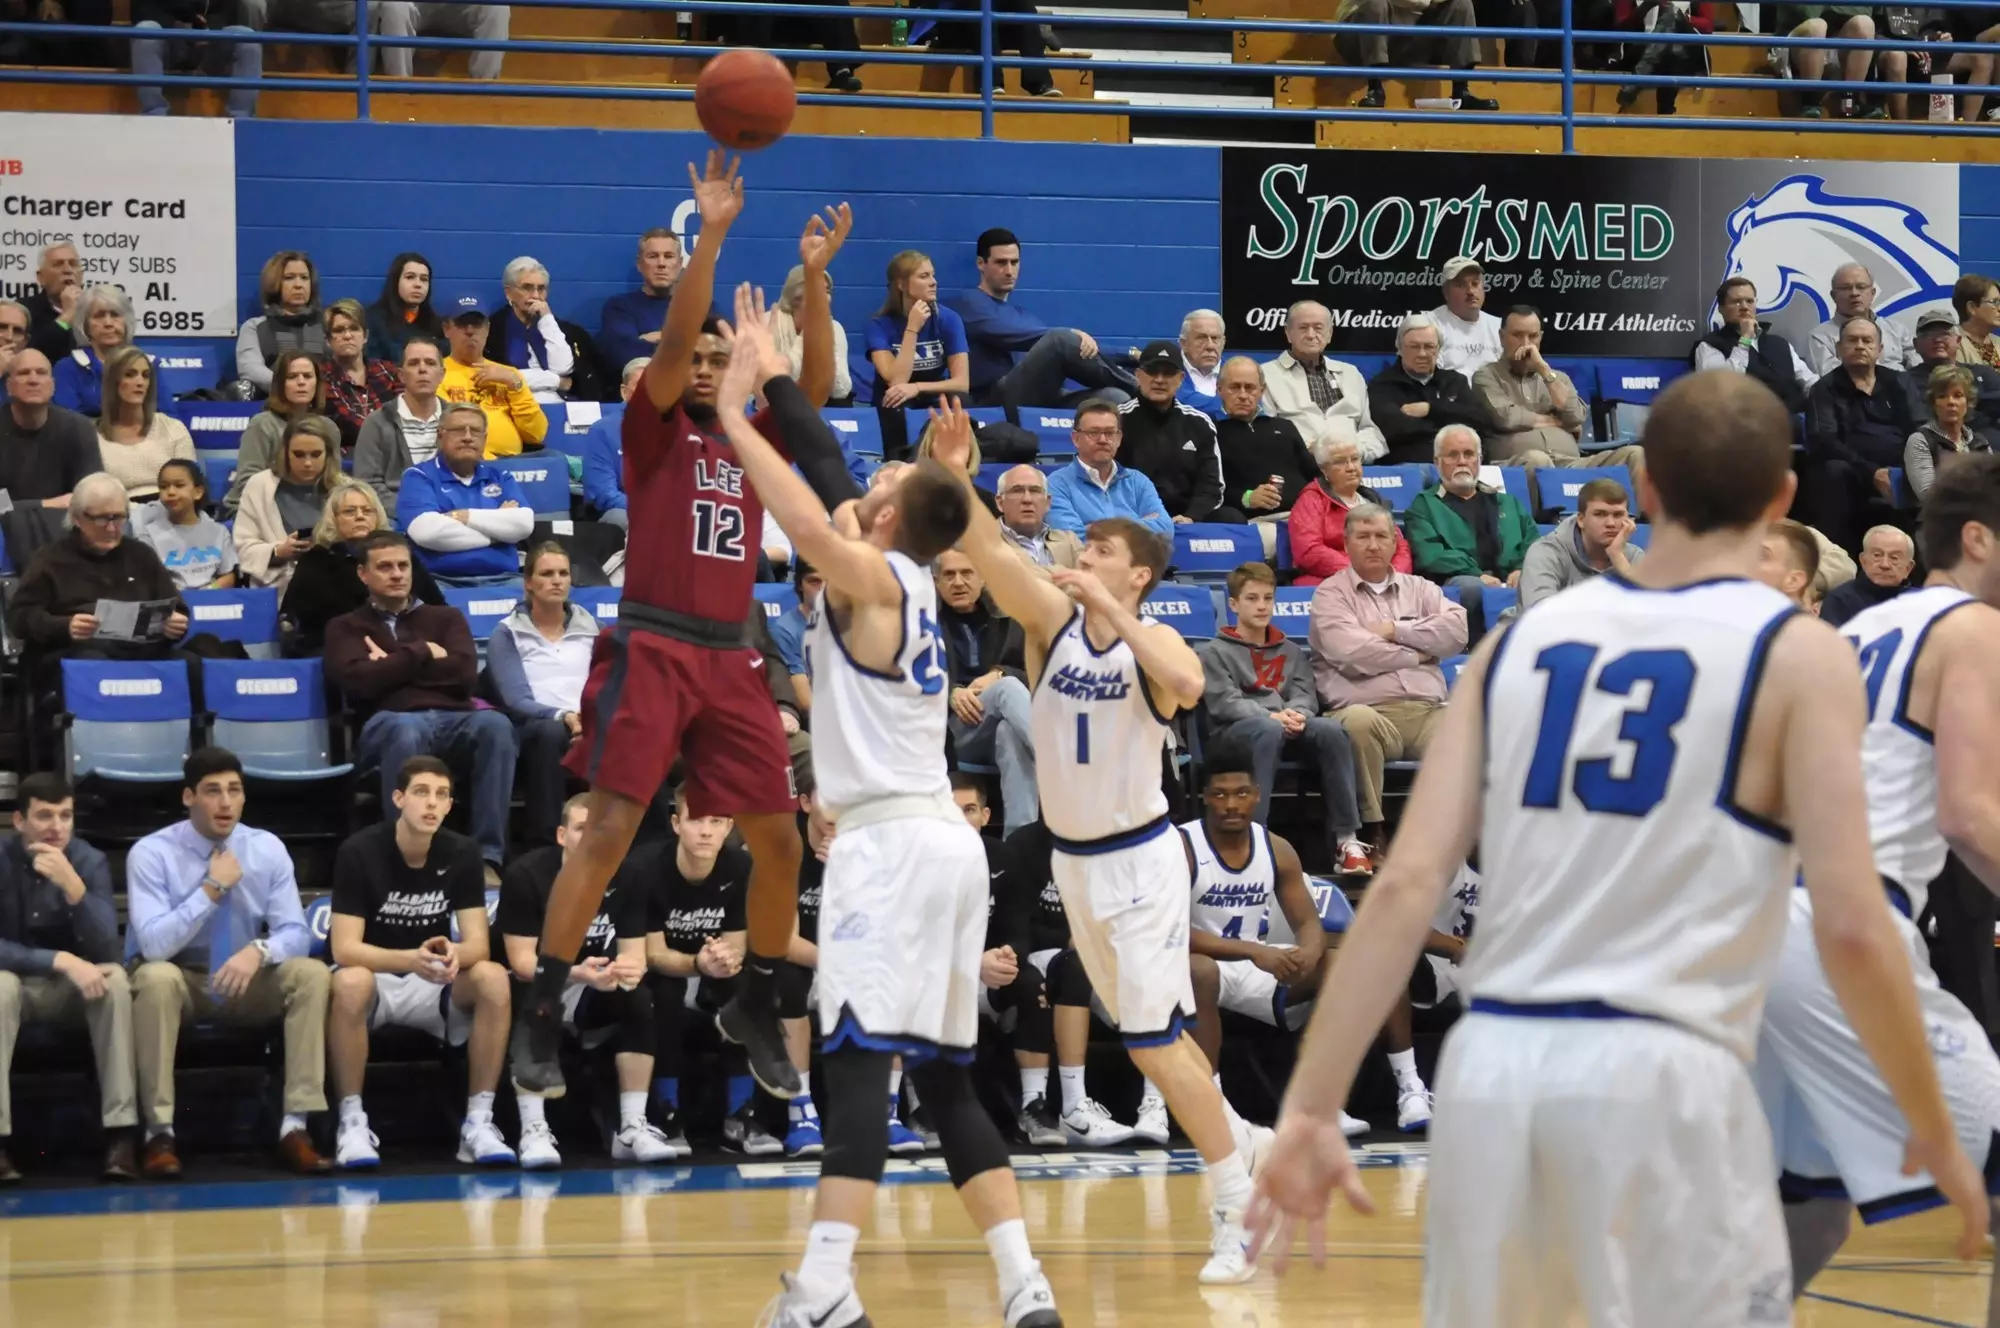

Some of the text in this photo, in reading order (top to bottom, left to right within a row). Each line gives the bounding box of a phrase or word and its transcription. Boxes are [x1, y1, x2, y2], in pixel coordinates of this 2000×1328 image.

[1238, 31, 1248, 48] 3
[1079, 70, 1089, 85] 2
[1280, 76, 1289, 92] 2
[1319, 124, 1325, 140] 1
[4, 195, 186, 220] Charger Card
[83, 232, 140, 252] today
[81, 257, 120, 276] asty
[129, 257, 177, 274] SUBS
[1327, 263, 1443, 291] Orthopaedic
[1483, 272, 1522, 293] gery
[1550, 269, 1602, 294] Spine
[1607, 270, 1669, 291] Center
[1246, 307, 1288, 332] Offi
[1553, 313, 1606, 332] UAH
[1611, 313, 1696, 333] Athletics
[695, 458, 744, 499] LEE
[692, 499, 745, 561] 12
[1077, 712, 1090, 764] 1
[1521, 641, 1698, 818] 13
